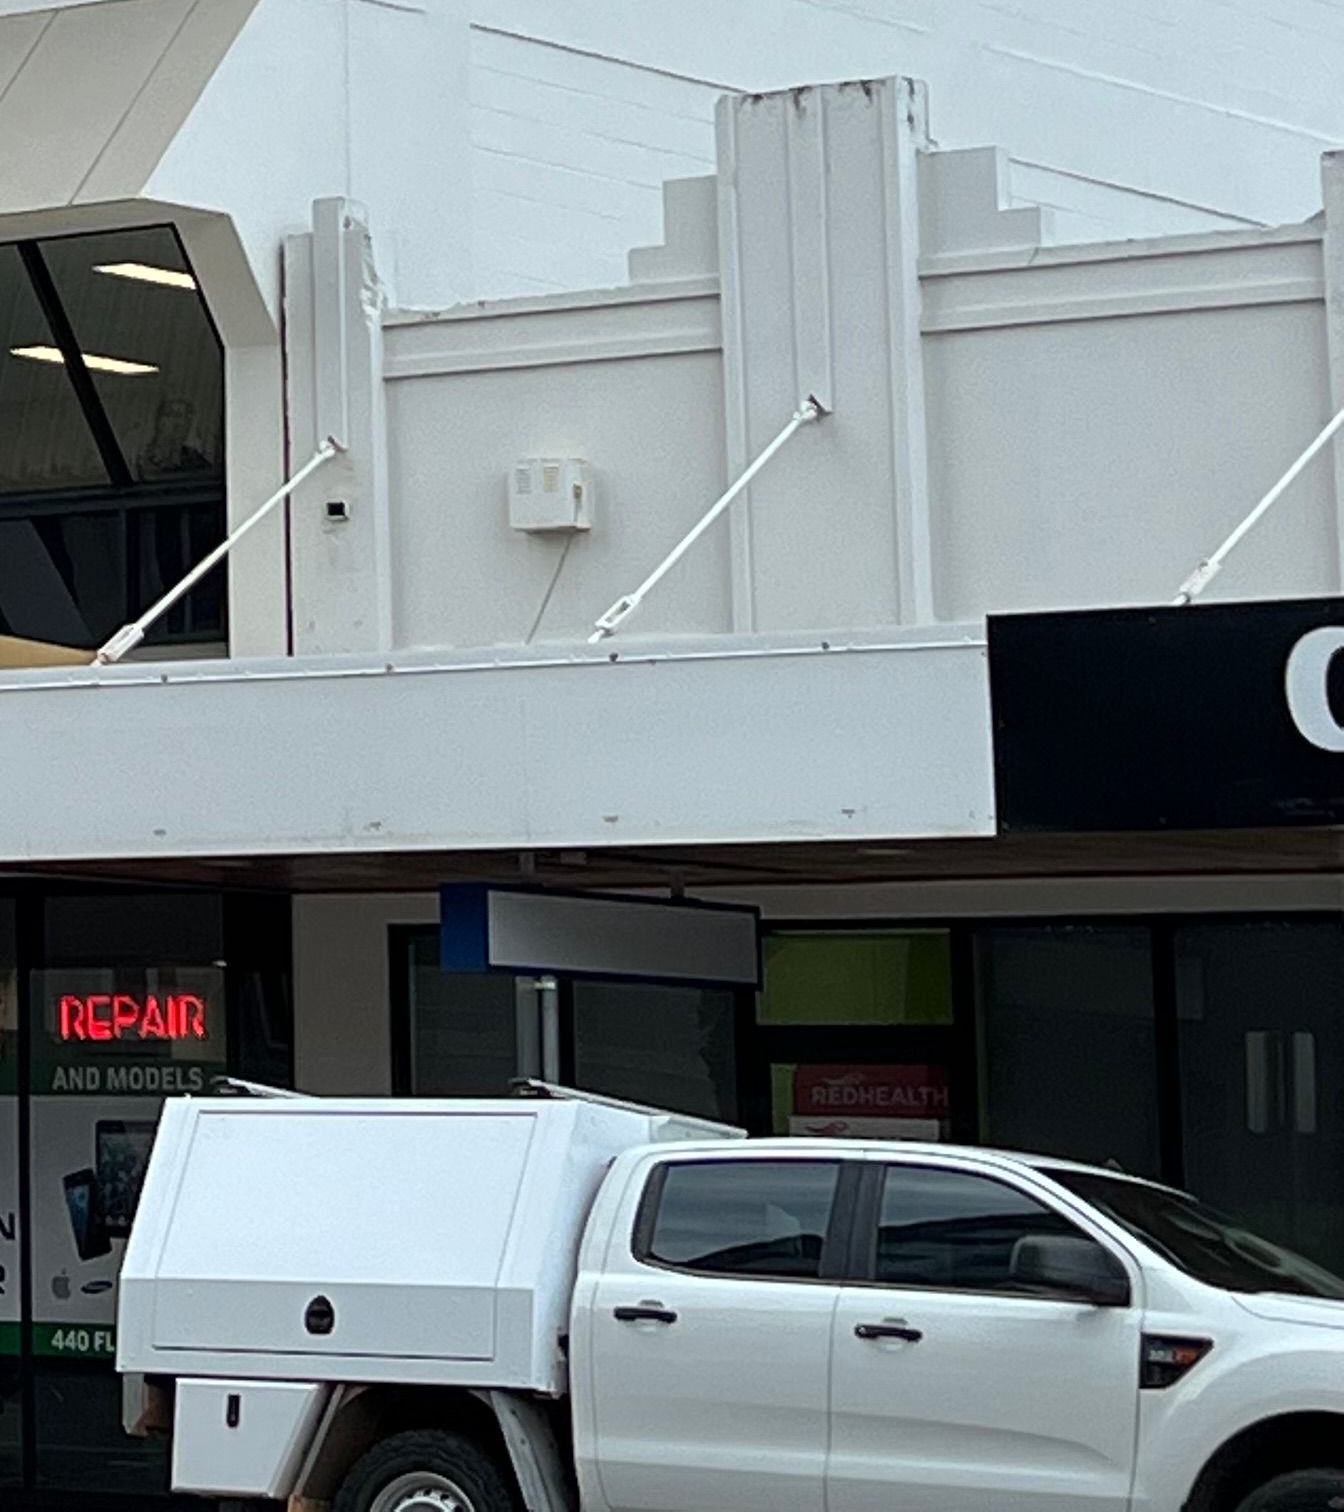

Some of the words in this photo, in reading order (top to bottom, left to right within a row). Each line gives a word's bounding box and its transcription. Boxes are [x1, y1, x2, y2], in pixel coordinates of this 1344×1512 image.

[60, 995, 205, 1040] REPAIR
[53, 1067, 100, 1090] AND
[109, 1067, 202, 1090] MODELS
[51, 1330, 89, 1351] 440
